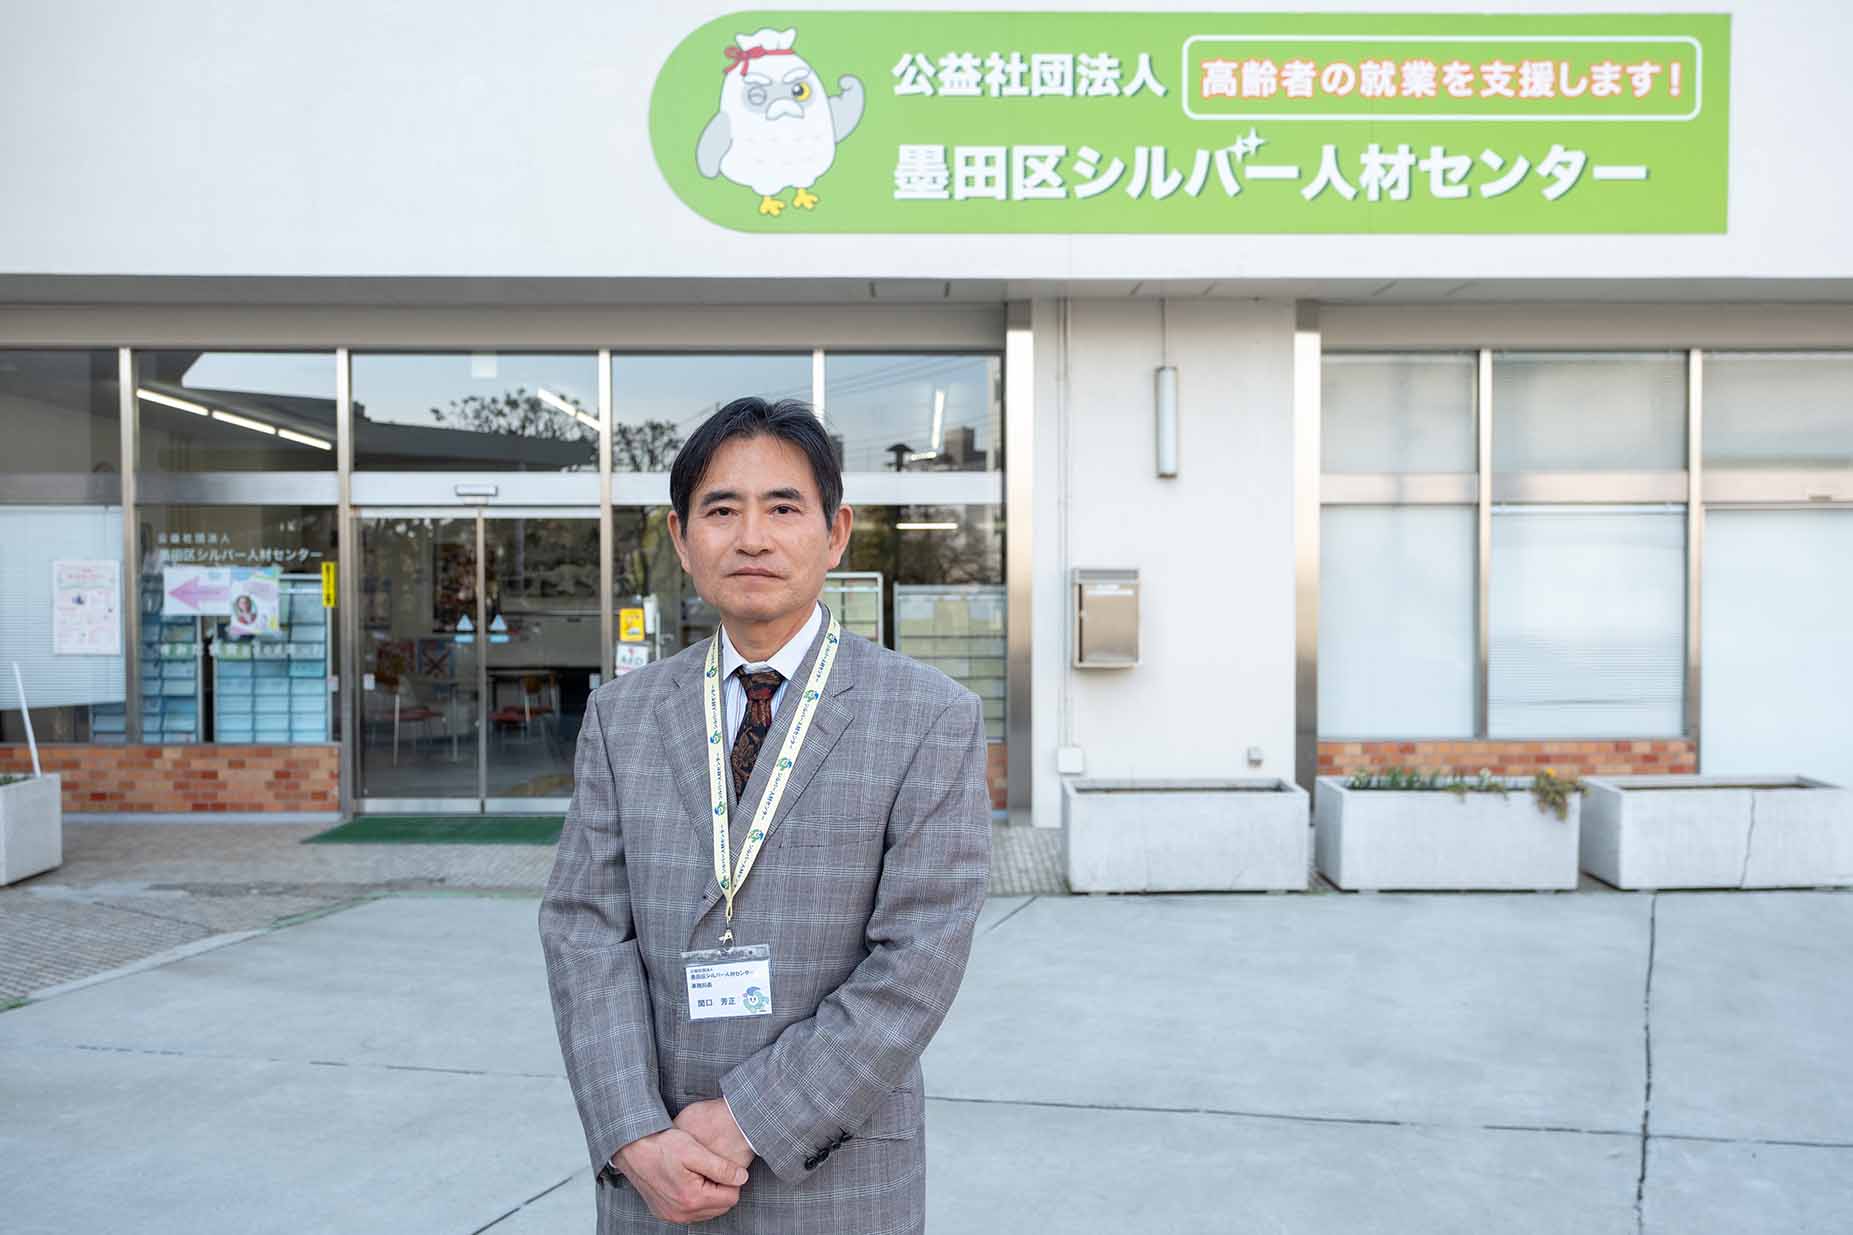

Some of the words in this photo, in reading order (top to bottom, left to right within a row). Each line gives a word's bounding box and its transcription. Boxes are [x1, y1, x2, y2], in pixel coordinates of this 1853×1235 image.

[892, 52, 1168, 98] 公益社団法人
[1200, 58, 1684, 100] 高齢者の就業を支援します！
[892, 131, 1649, 201] 墨田区シルバー人材センター
